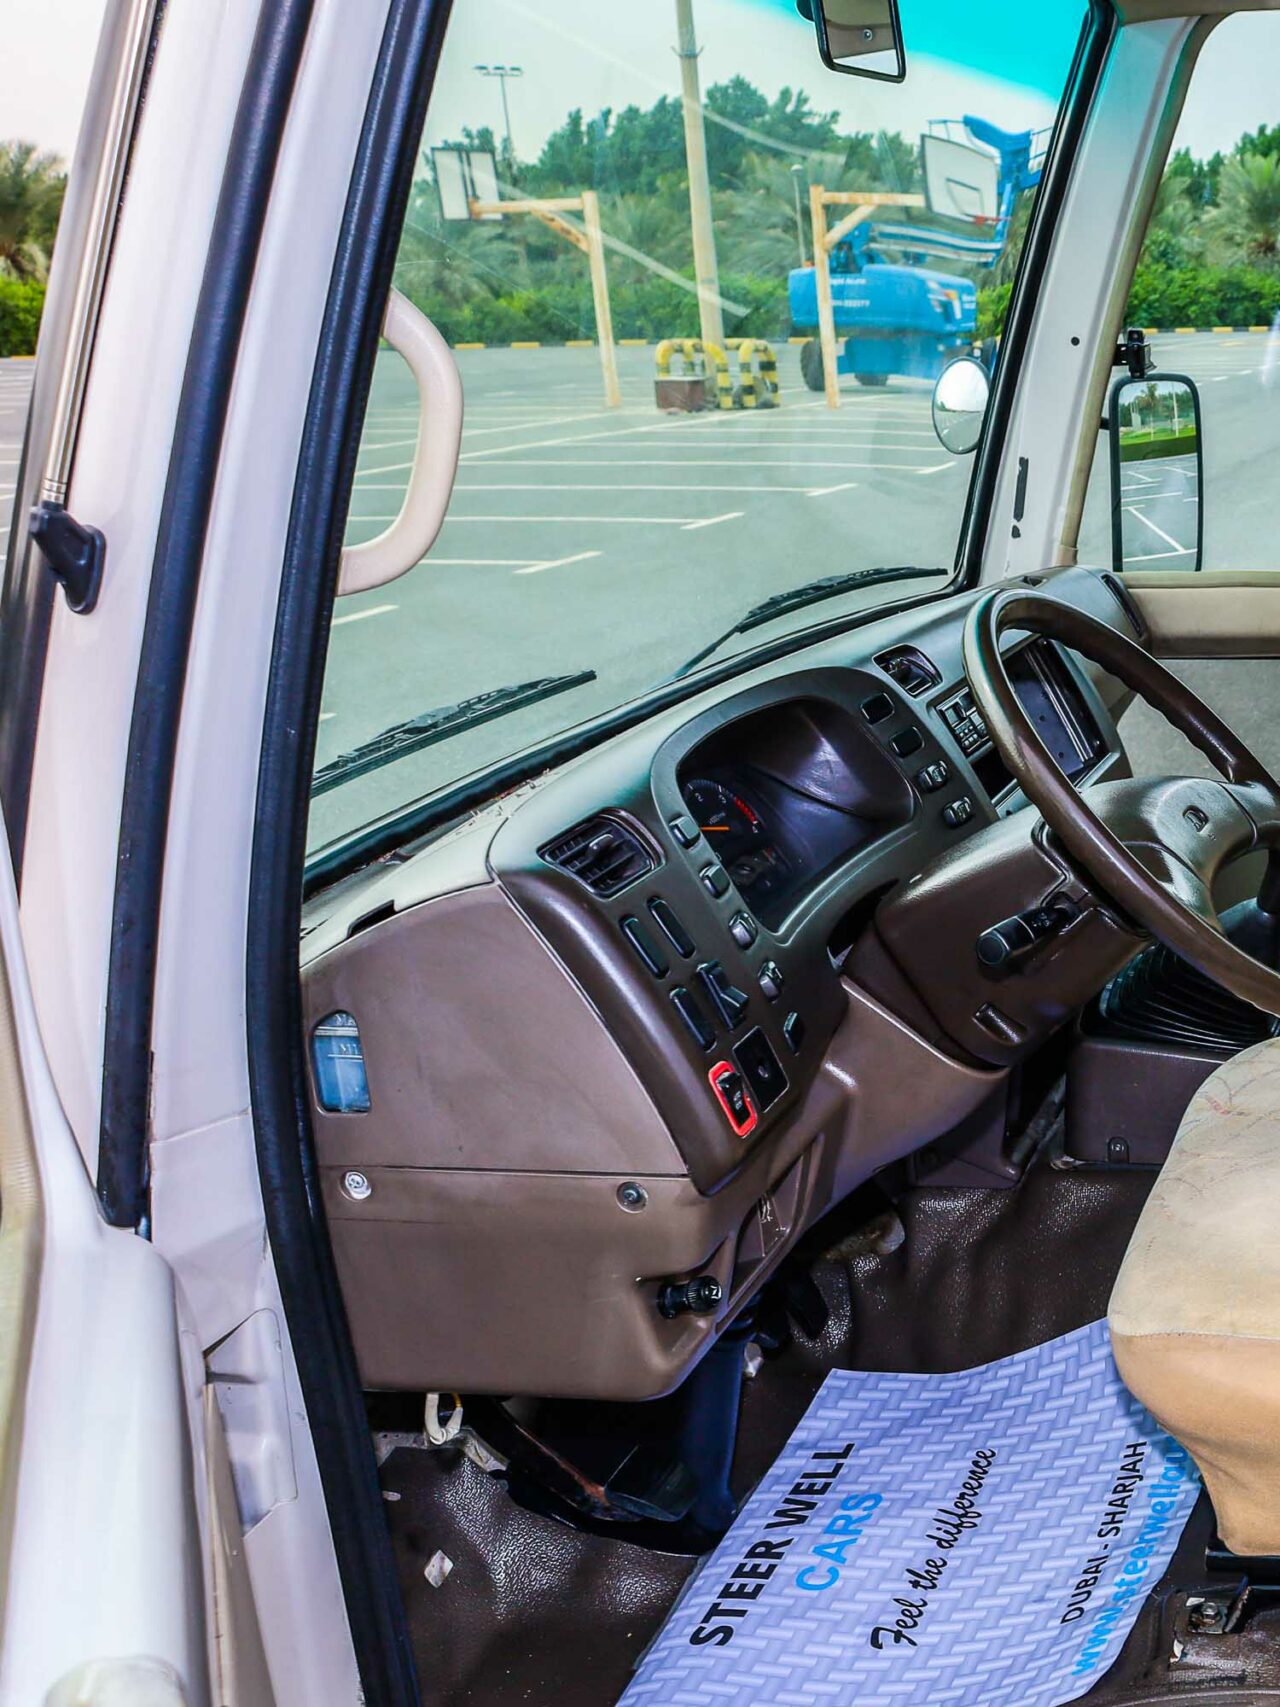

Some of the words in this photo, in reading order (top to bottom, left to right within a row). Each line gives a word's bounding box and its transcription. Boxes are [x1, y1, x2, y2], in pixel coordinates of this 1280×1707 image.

[689, 1537, 795, 1646] STEER
[763, 1442, 856, 1530] WELL
[795, 1492, 884, 1591] CARS
[926, 1448, 997, 1550] difference
[1060, 1558, 1108, 1625] DUBAI
[1097, 1441, 1147, 1538] SHARJAH
[905, 1556, 948, 1591] the
[1072, 1435, 1190, 1676] www.steerwellau
[870, 1597, 928, 1650] Feel
